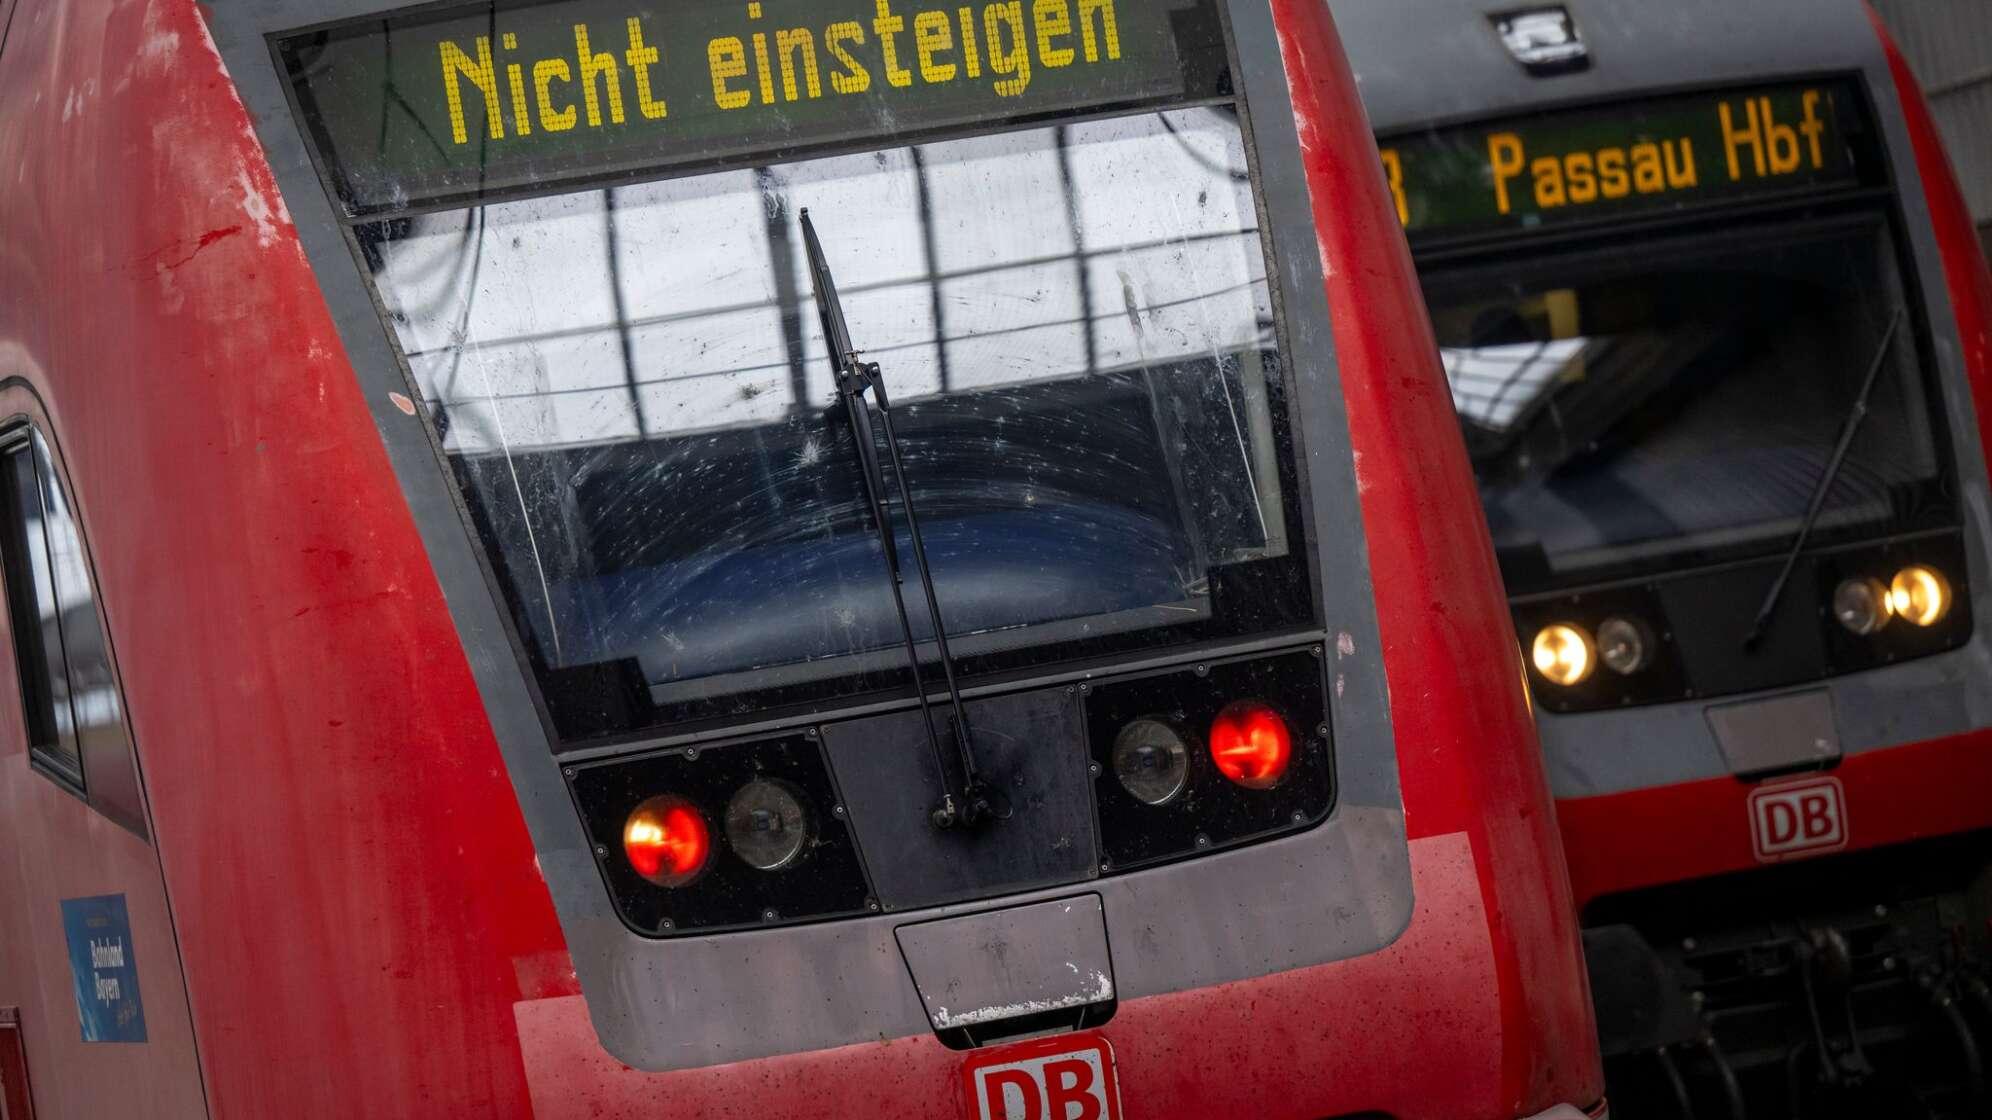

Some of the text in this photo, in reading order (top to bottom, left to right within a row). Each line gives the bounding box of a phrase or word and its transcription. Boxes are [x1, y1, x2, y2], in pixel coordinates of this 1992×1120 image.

[440, 0, 1121, 144] Nicht einsteigen
[1488, 132, 1697, 214] Passau
[1718, 89, 1824, 181] Hbf
[1764, 794, 1833, 845] DB
[94, 971, 120, 1008] Bayern
[984, 1059, 1101, 1120] DB
